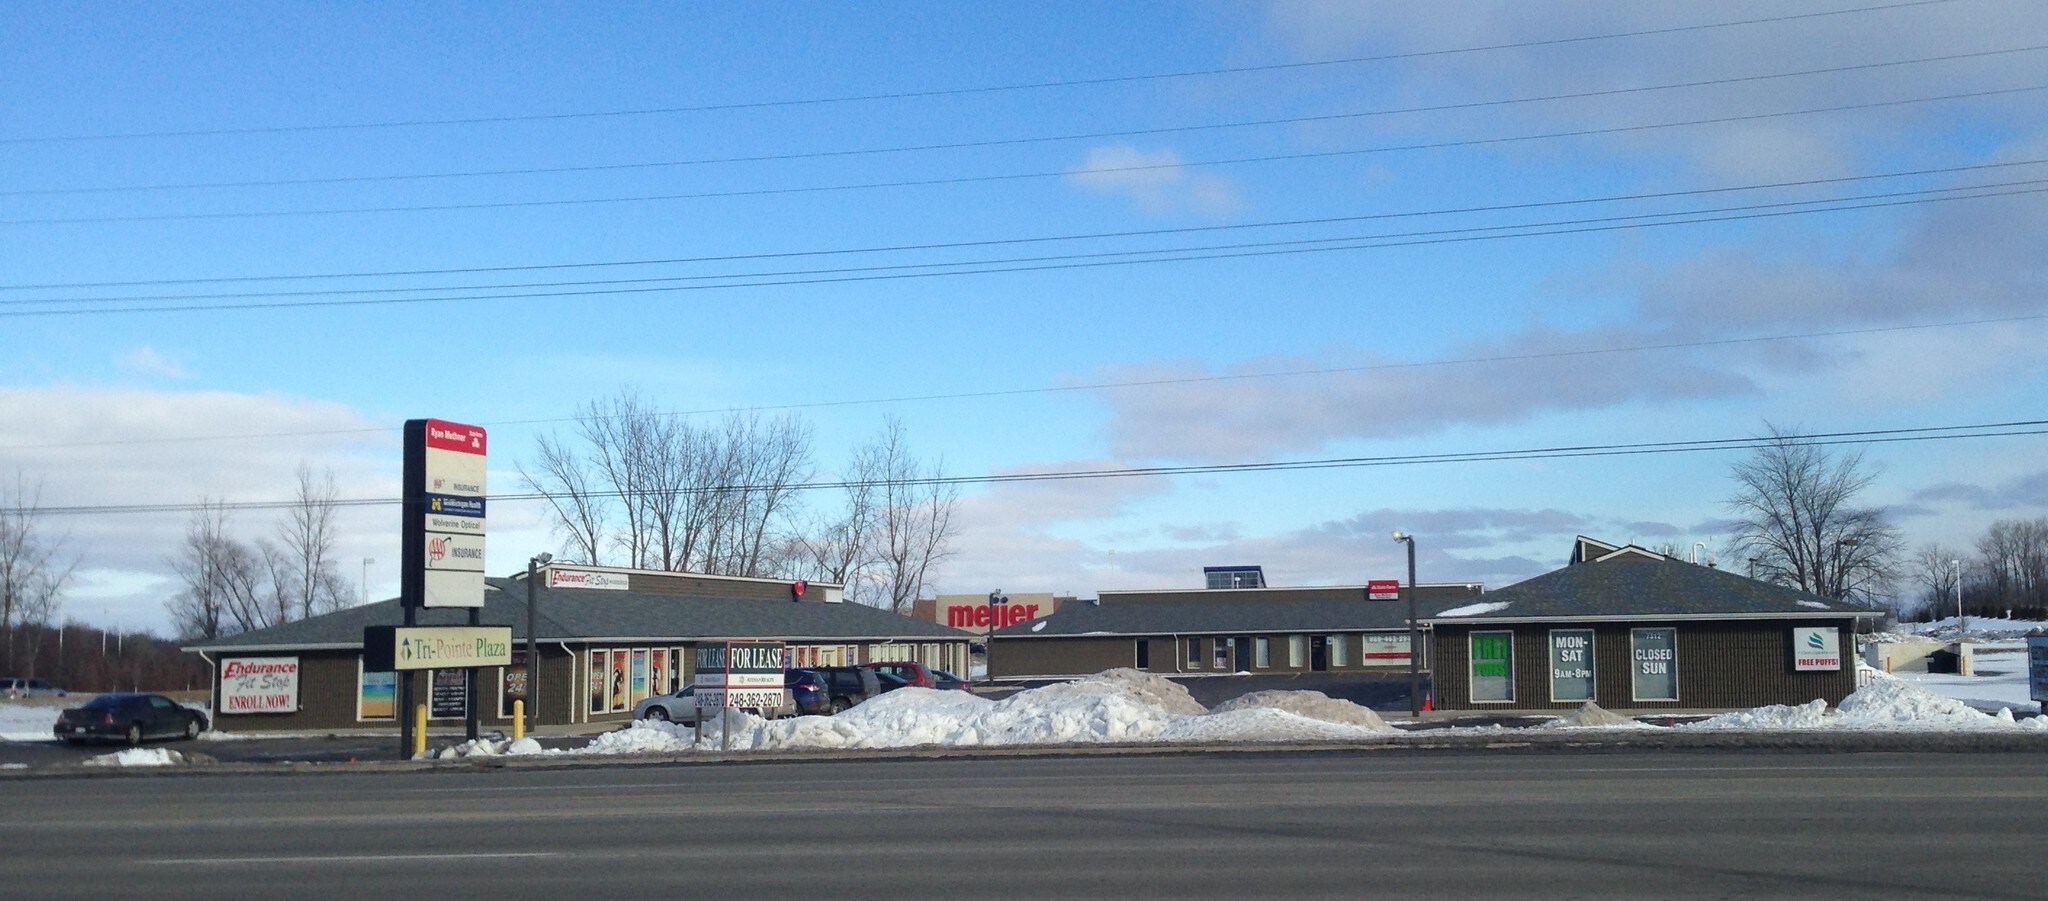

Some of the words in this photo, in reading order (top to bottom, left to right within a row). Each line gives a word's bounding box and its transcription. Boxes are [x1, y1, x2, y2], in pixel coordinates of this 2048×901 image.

[431, 427, 445, 439] Ryan
[453, 483, 480, 493] INSURANCE
[432, 518, 459, 528] Wolverine
[460, 520, 481, 529] Optical
[452, 547, 482, 559] INSURANCE
[553, 571, 585, 585] Endurance
[948, 597, 1038, 629] meijer
[415, 638, 473, 660] Tri-Pointe
[476, 637, 506, 658] Plaza
[1556, 636, 1588, 649] MON-
[731, 648, 751, 669] FOR
[753, 648, 783, 669] LEASE
[1561, 650, 1583, 662] SAT
[1635, 649, 1673, 661] CLOSED
[1642, 662, 1667, 674] SUN
[1799, 658, 1814, 666] FREE
[1815, 658, 1839, 666] PUFFS!
[224, 661, 297, 680] Endurance
[506, 672, 528, 682] OPE
[235, 675, 256, 692] Fit
[228, 695, 265, 710] ENROLL
[265, 695, 290, 709] NOW!
[729, 692, 782, 707] 248-362-2870
